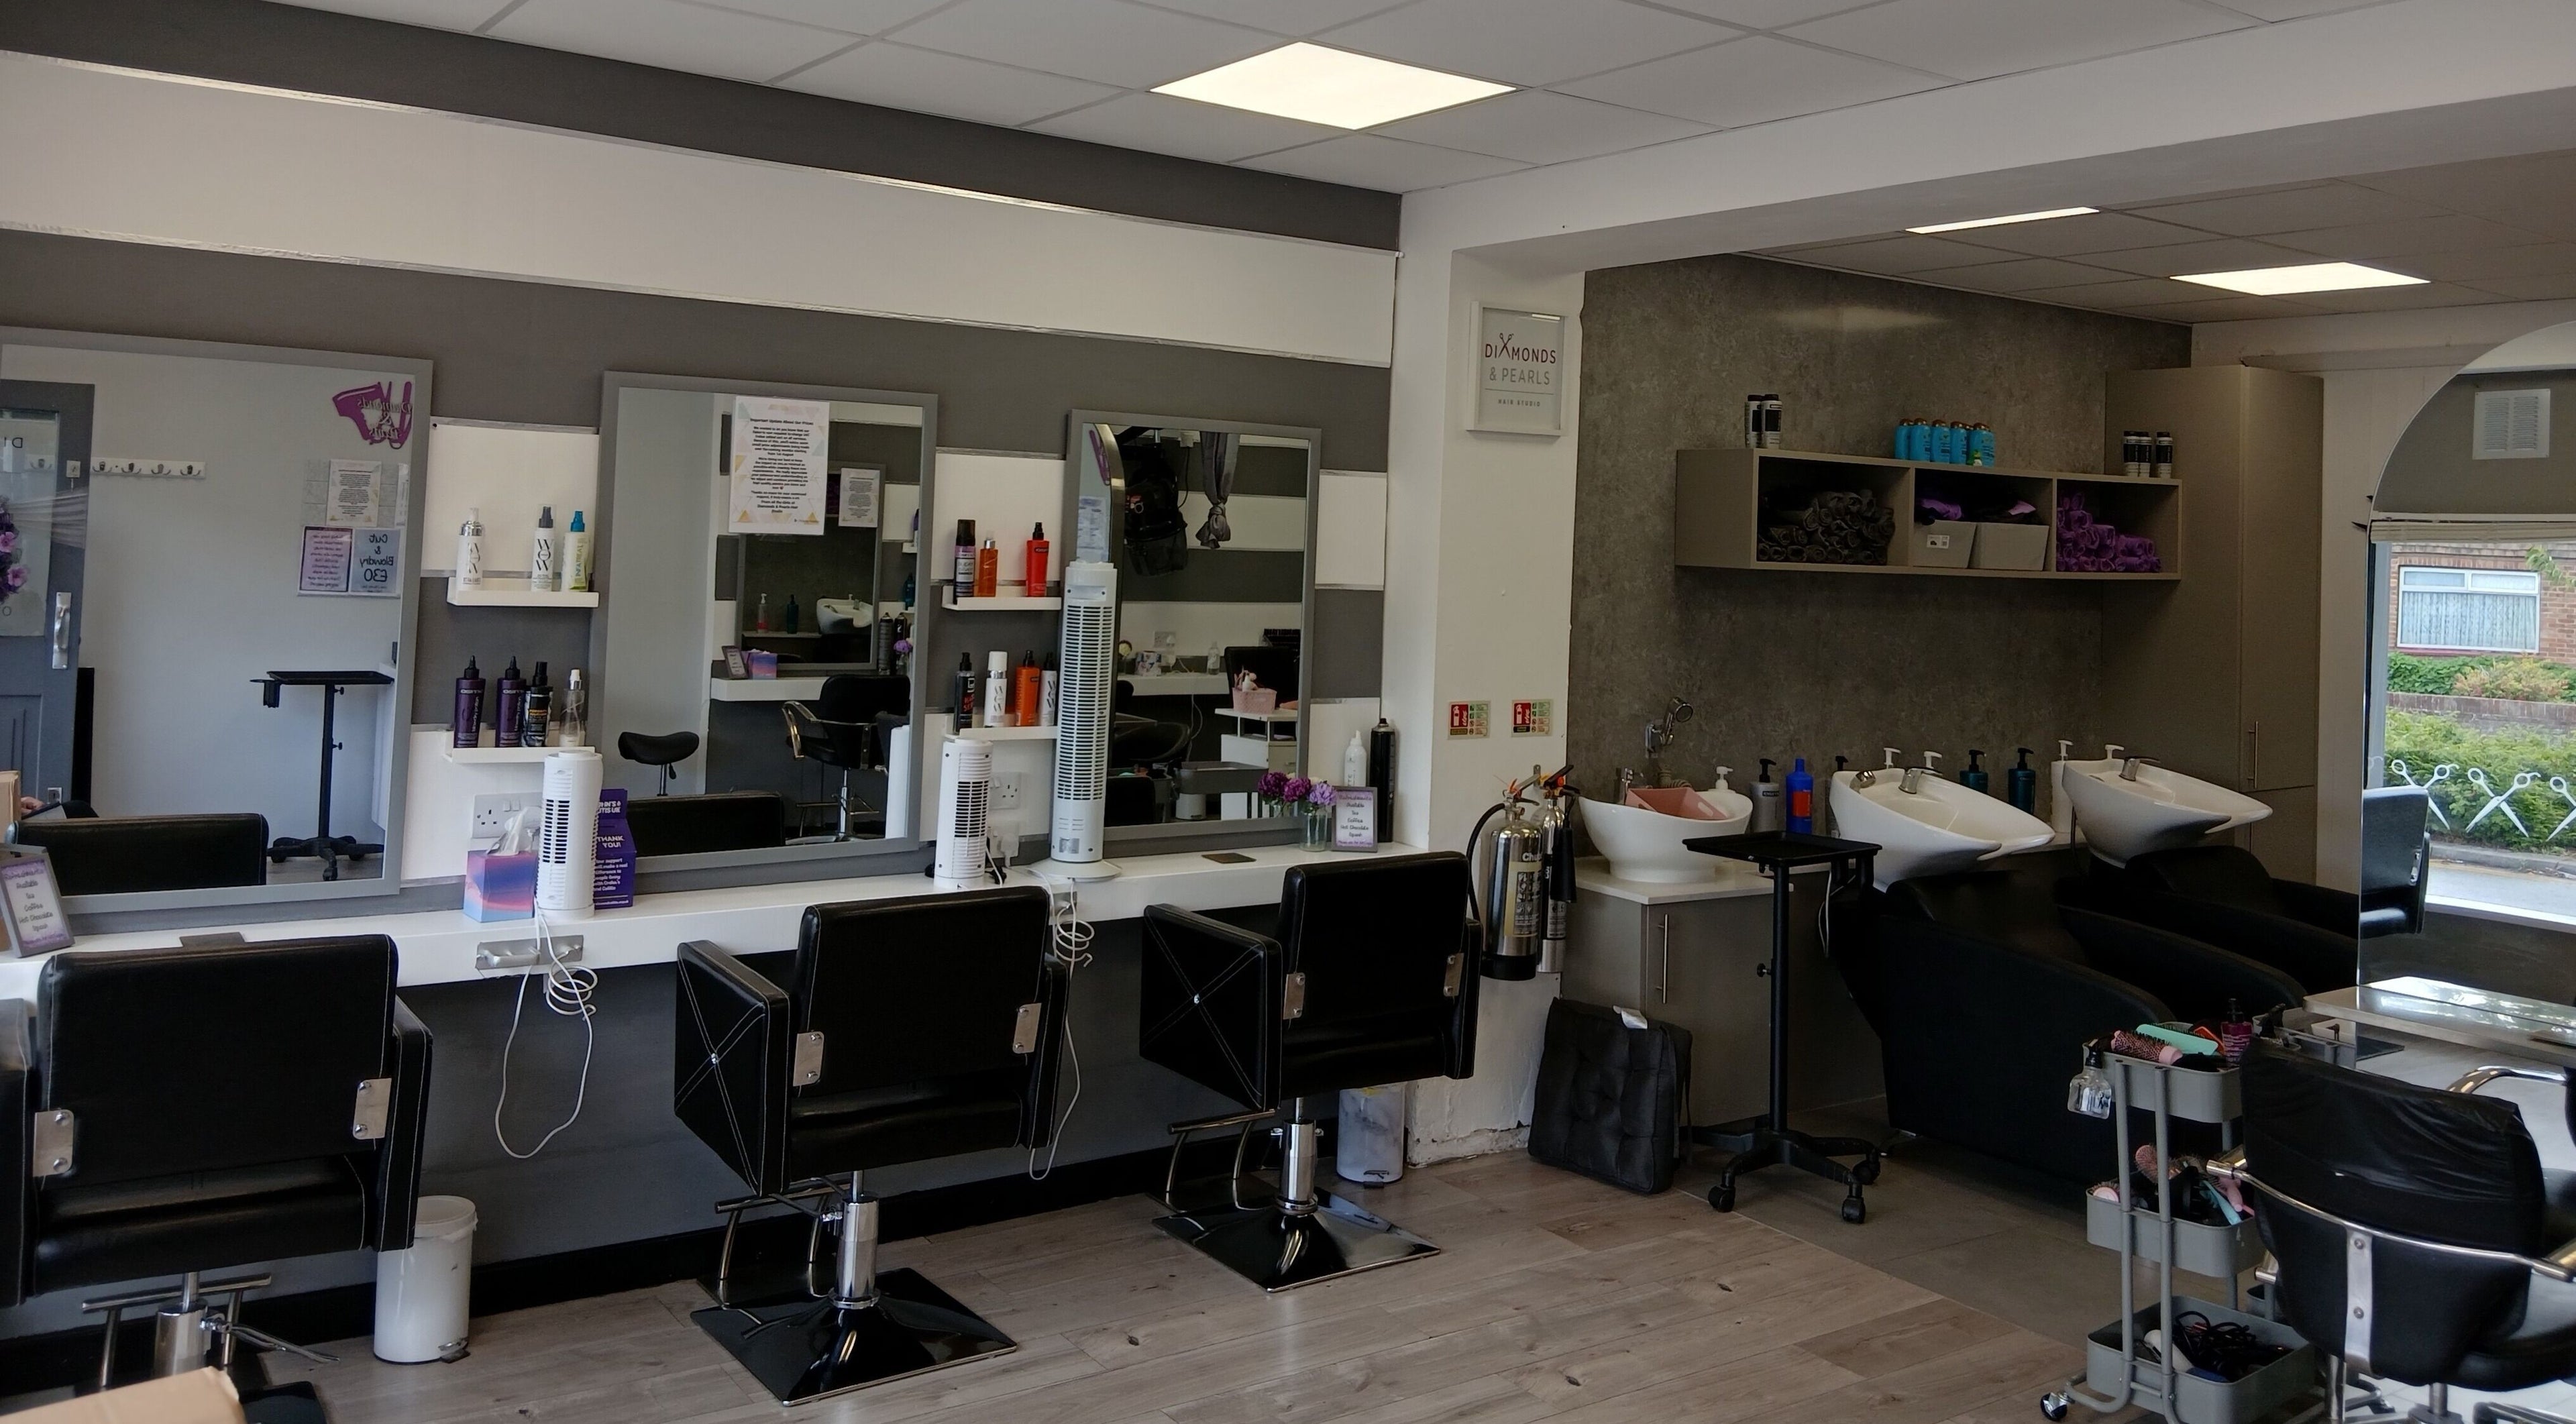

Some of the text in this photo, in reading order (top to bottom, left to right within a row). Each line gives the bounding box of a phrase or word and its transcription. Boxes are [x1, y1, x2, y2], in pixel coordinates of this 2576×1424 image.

[1485, 333, 1556, 364] DIAMONDS
[1489, 366, 1550, 385] & PEARLS
[1517, 399, 1541, 407] STUDIO
[24, 903, 43, 912] Coffee
